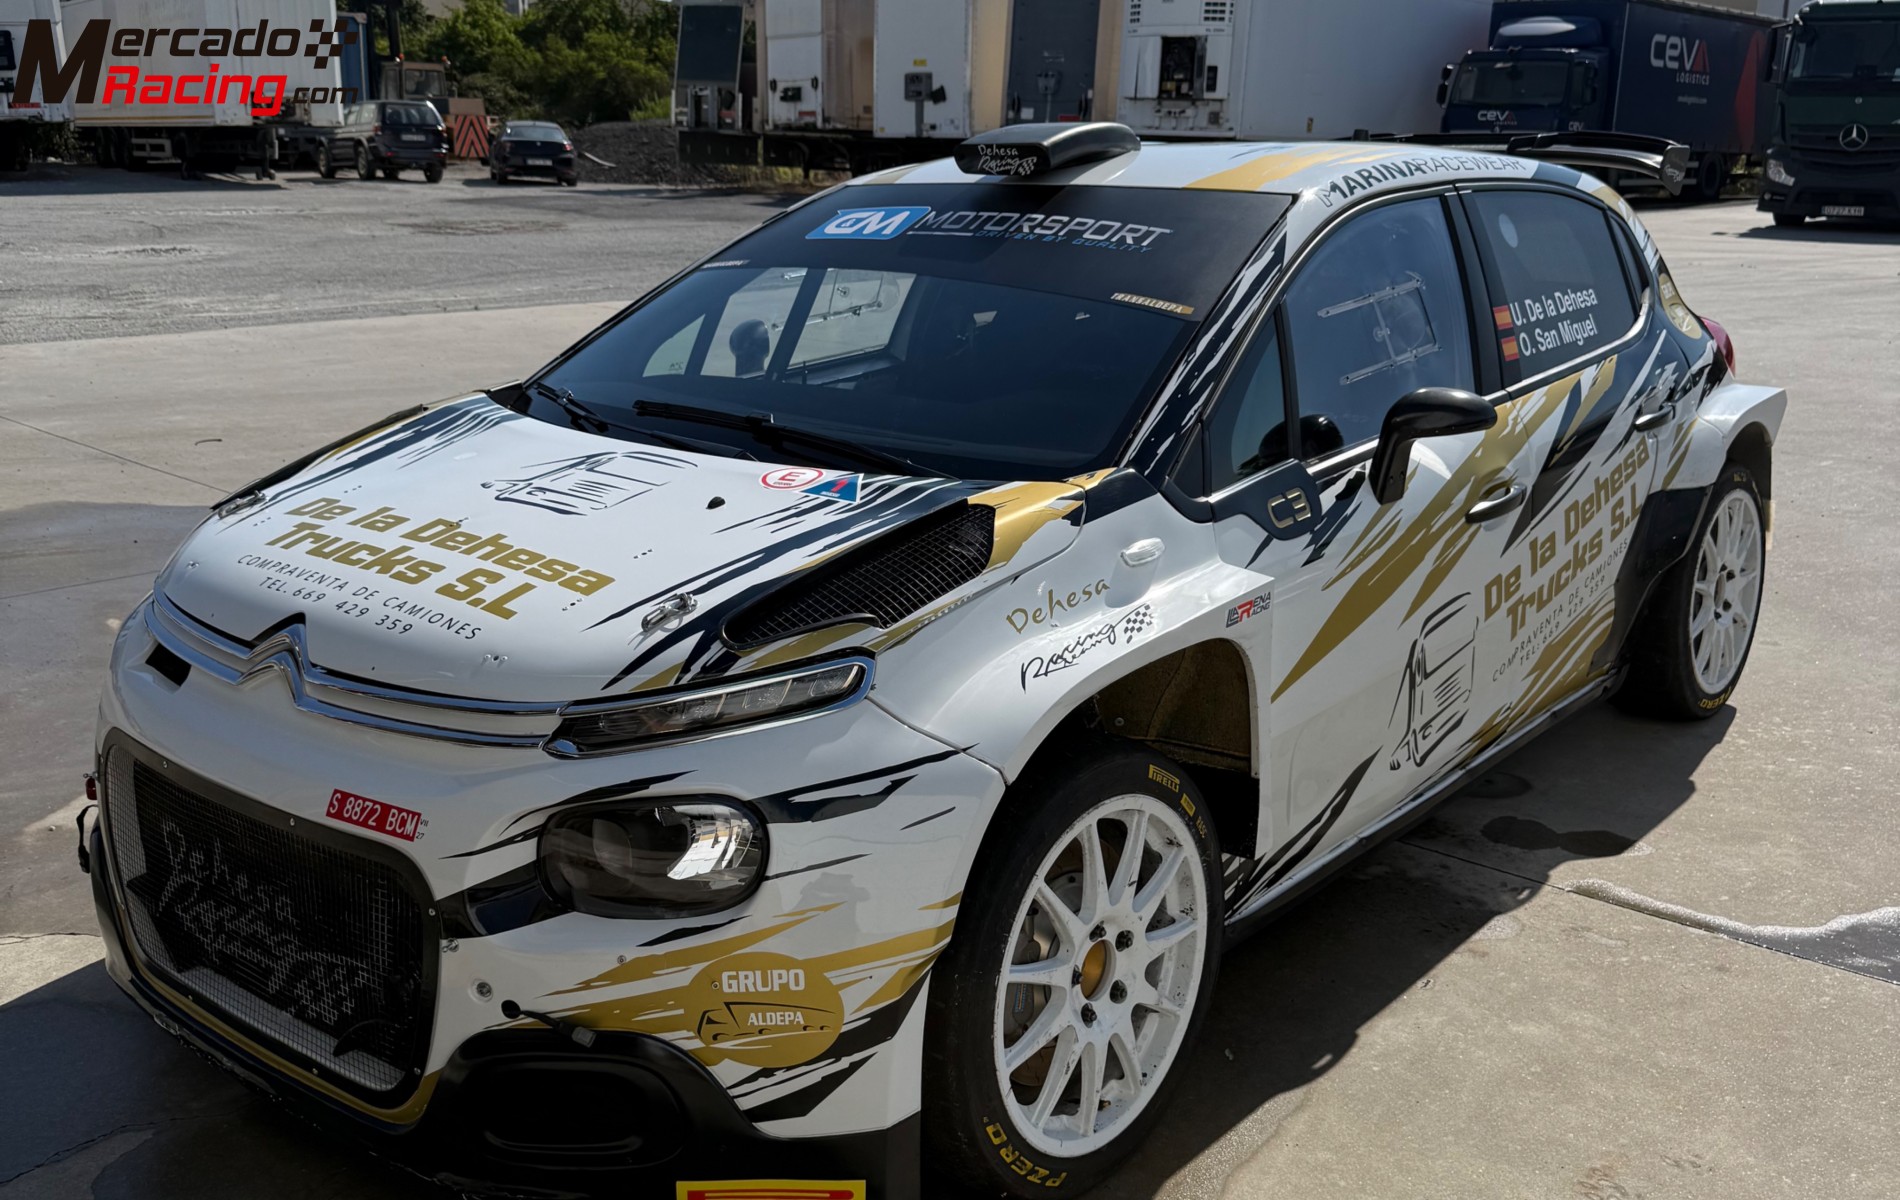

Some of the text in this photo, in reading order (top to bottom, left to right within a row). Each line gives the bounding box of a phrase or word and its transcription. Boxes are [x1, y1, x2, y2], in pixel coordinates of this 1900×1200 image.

[978, 144, 1018, 156] Dehesa
[914, 211, 1171, 247] MOTORSPORT
[975, 230, 1152, 253] DRIVEN BY QUALITY
[1509, 287, 1598, 327] U. De la Dehesa
[1519, 313, 1598, 357] O. San Miguel
[1268, 488, 1311, 529] C3
[1484, 434, 1650, 623] De la Dehesa
[284, 498, 616, 596] De la Dehesa
[1506, 482, 1643, 642] Trucks S.L
[265, 521, 538, 620] Trucks S.L
[237, 554, 482, 640] COMPRAVENTA DE CAMIONES
[259, 576, 414, 635] TEL. 669 429 359
[1006, 579, 1111, 634] Dehesa
[1492, 537, 1629, 682] COMPRAVENTA DE CAMIONES
[1567, 597, 1584, 618] 429
[1589, 574, 1606, 598] 359
[1021, 621, 1118, 693] Racing
[1148, 764, 1180, 793] PIRELLI
[329, 793, 419, 837] S 8872 BCM
[415, 831, 425, 840] 27
[721, 968, 806, 993] GRUPO
[747, 1011, 805, 1026] ALDEPA
